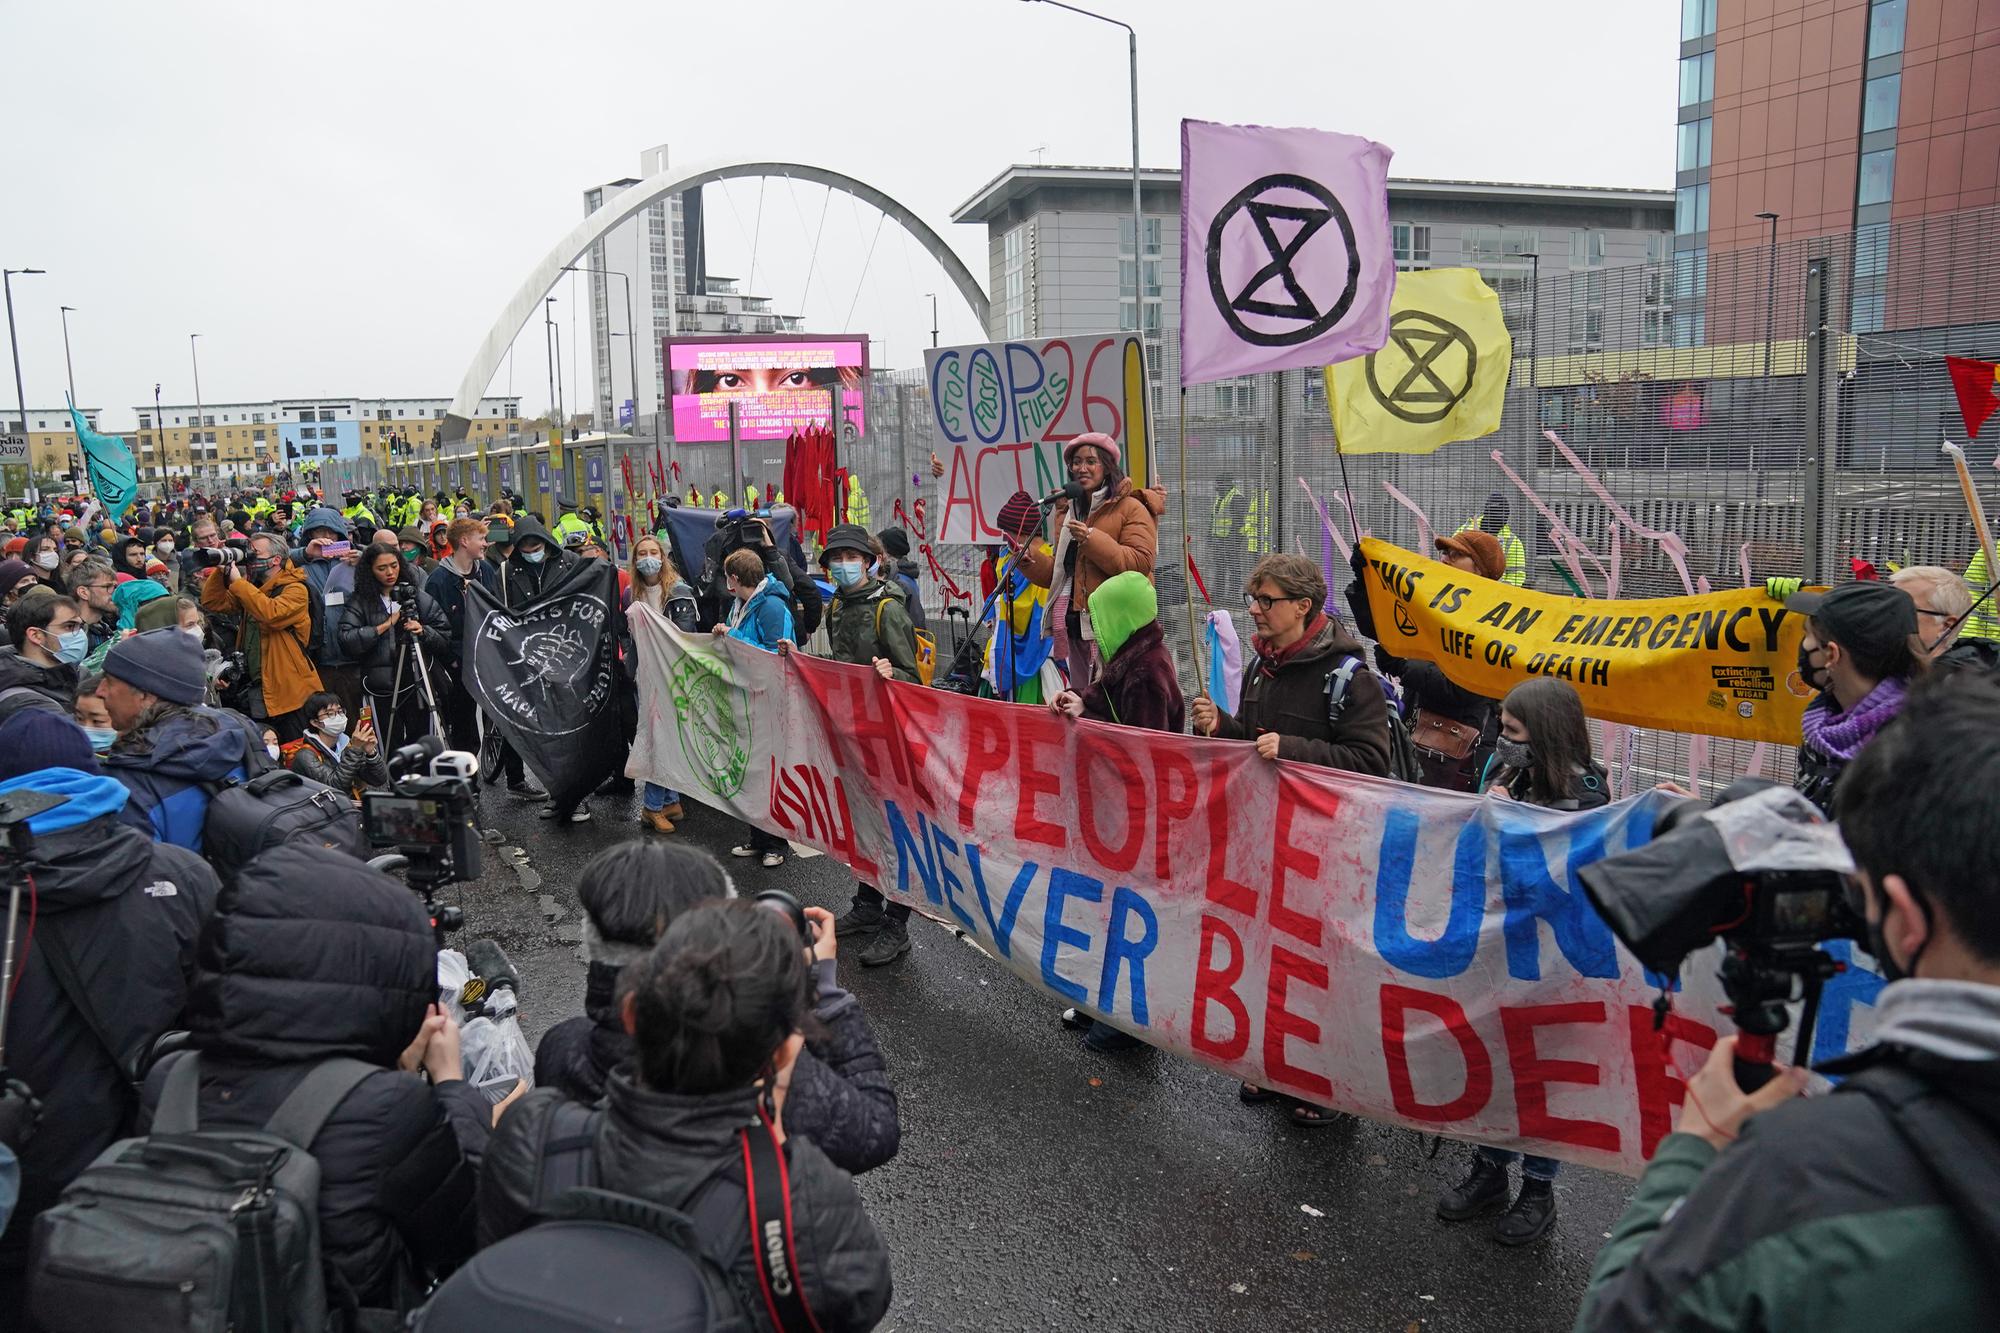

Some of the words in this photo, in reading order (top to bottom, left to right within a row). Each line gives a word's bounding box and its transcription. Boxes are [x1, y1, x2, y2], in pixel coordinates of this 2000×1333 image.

[943, 360, 966, 432] STOP
[1018, 371, 1069, 437] FUELS
[569, 601, 605, 629] FOR
[1369, 559, 1425, 603] THIS
[1429, 583, 1472, 614] IS
[1476, 601, 1543, 635] AN
[1552, 606, 1789, 652] EMERGENCY
[1440, 627, 1476, 660] LIFE
[1484, 639, 1518, 670] OR
[1526, 653, 1611, 688] DEATH
[1714, 667, 1762, 678] extinction
[1729, 679, 1773, 690] rebellion
[958, 709, 1340, 949] PEOPLE
[884, 800, 1160, 1028] NEVER
[1191, 915, 1334, 1100] BE
[764, 1219, 793, 1296] Canon
